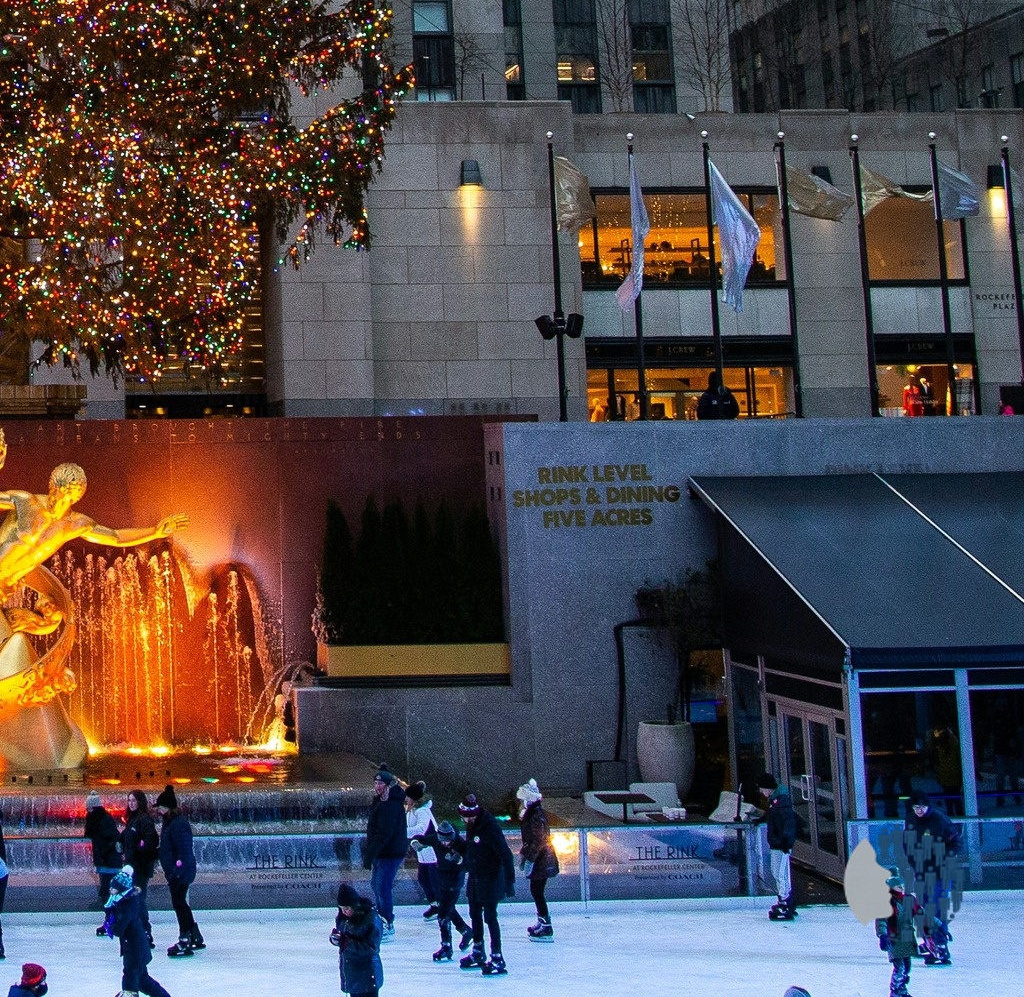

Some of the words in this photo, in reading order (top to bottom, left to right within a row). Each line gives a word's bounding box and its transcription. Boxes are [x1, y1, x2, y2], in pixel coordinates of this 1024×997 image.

[537, 466, 588, 484] RINK
[593, 464, 652, 483] LEVEL
[513, 488, 581, 507] SHOPS
[586, 487, 602, 504] &
[606, 485, 680, 503] DINING
[543, 510, 586, 528] FIVE
[591, 508, 653, 526] ACRES
[253, 855, 279, 868] THE
[285, 854, 318, 868] RINK
[636, 846, 661, 859] THE
[667, 845, 699, 859] RINK
